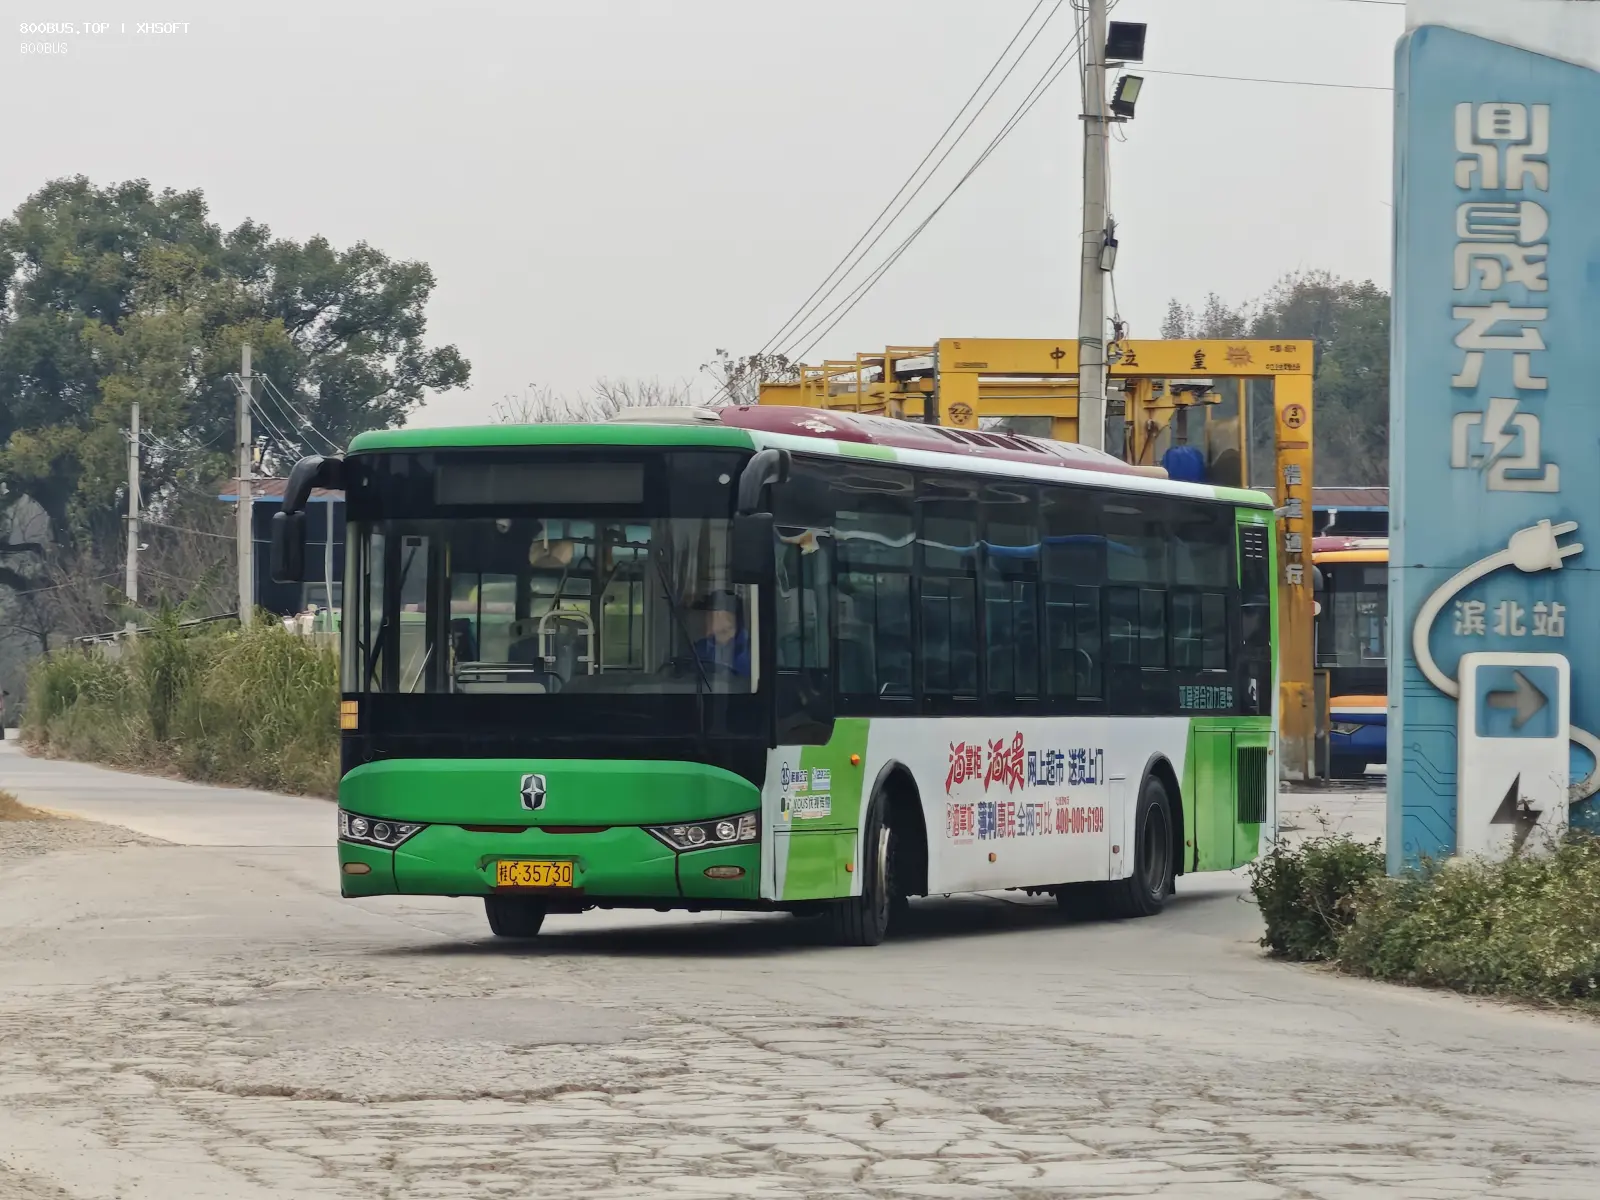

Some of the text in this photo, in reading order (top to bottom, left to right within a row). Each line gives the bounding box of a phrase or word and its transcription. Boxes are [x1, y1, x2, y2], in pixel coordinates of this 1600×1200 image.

[1453, 600, 1566, 638] 滨北站
[1028, 749, 1064, 787] 网上超市
[1068, 748, 1104, 786] 送货上门
[1056, 807, 1104, 834] 400-006-6199
